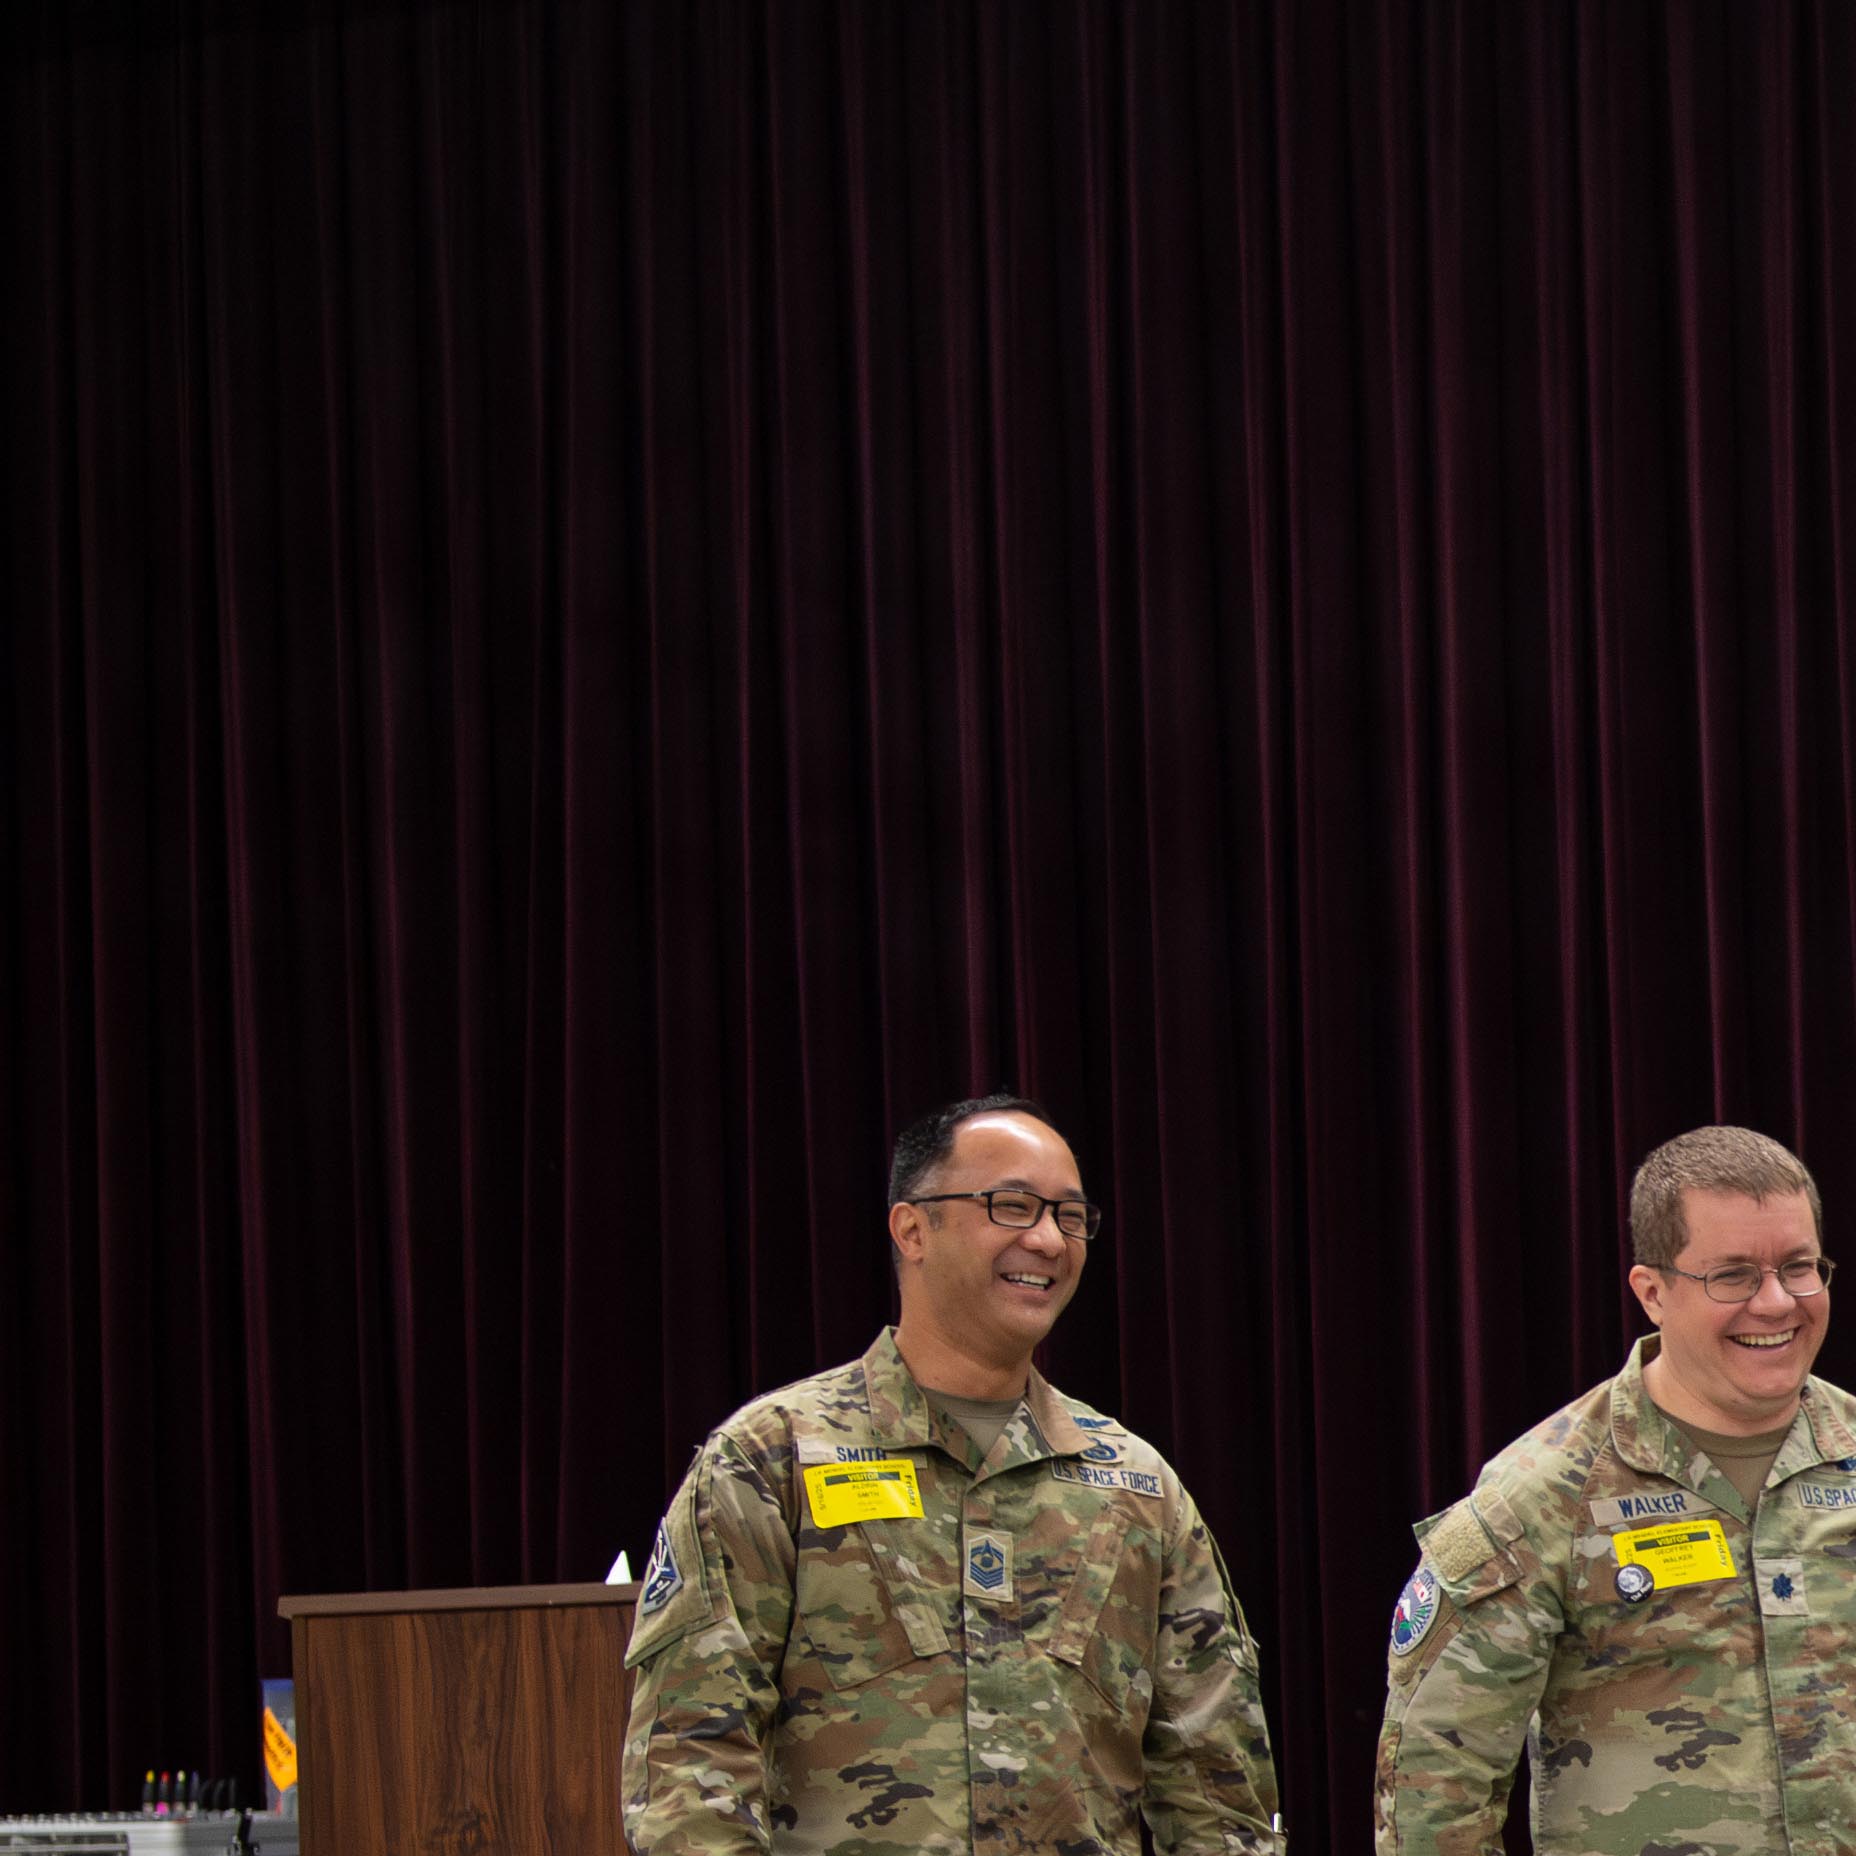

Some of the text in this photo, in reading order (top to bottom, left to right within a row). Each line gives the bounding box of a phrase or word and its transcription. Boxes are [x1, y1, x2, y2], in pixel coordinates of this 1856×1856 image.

[836, 1446, 887, 1462] SMITH
[847, 1472, 879, 1482] VISITOR
[1077, 1465, 1118, 1487] SPACE
[1120, 1470, 1161, 1495] FORCE
[905, 1474, 917, 1507] Friday
[1618, 1493, 1687, 1518] WALKER
[1656, 1534, 1690, 1547] VISITOR
[1715, 1534, 1728, 1567] Friday
[1663, 1553, 1693, 1564] WALKER
